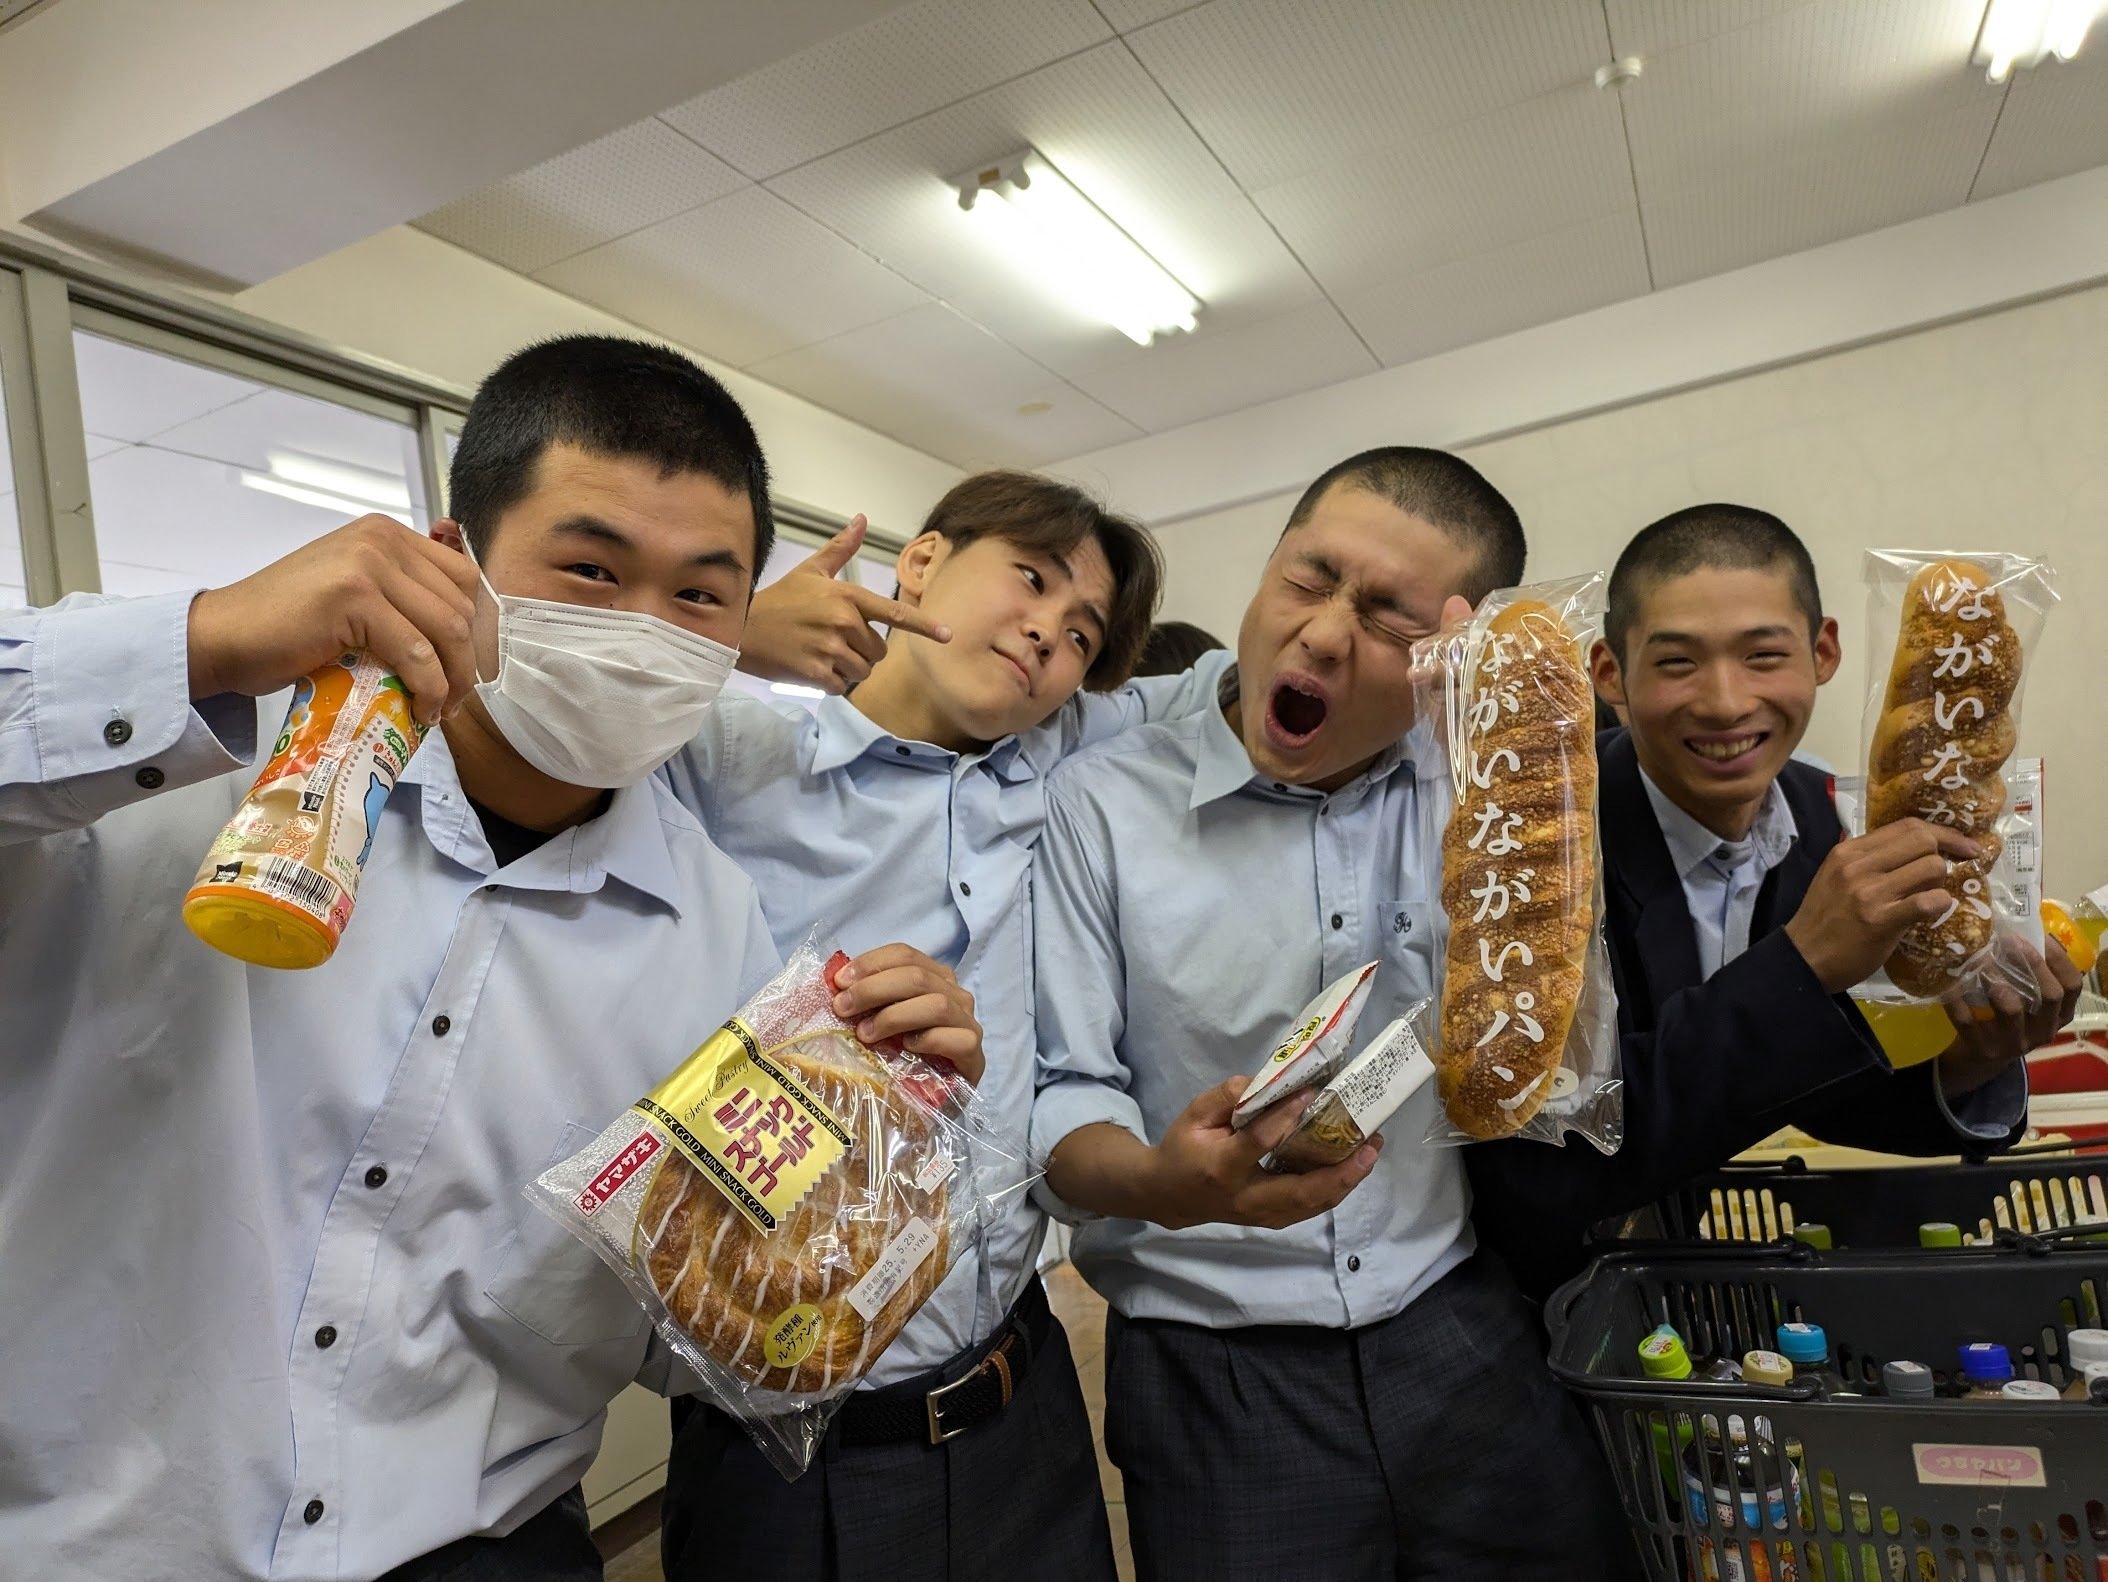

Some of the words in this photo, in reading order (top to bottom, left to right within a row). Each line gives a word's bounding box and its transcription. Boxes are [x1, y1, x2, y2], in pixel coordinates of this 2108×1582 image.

[1920, 576, 1998, 979] ながいながパン
[1467, 628, 1549, 1111] ながいながいパン
[684, 1091, 713, 1123] Sweet
[715, 1059, 750, 1091] Pastry
[755, 1057, 776, 1075] MINI
[777, 1075, 802, 1101] GOLD
[713, 1087, 764, 1134] ミニ
[723, 1095, 795, 1174] スナック
[800, 1099, 828, 1130] SNACK
[828, 1125, 847, 1143] MINI
[595, 1137, 653, 1194] ヤマザキ
[649, 1104, 674, 1129] SNACK
[674, 1126, 701, 1152] GOLD
[700, 1152, 722, 1174] MINI
[719, 1170, 750, 1203] SNACK
[747, 1198, 773, 1225] GOLD
[746, 1115, 816, 1198] ゴールド
